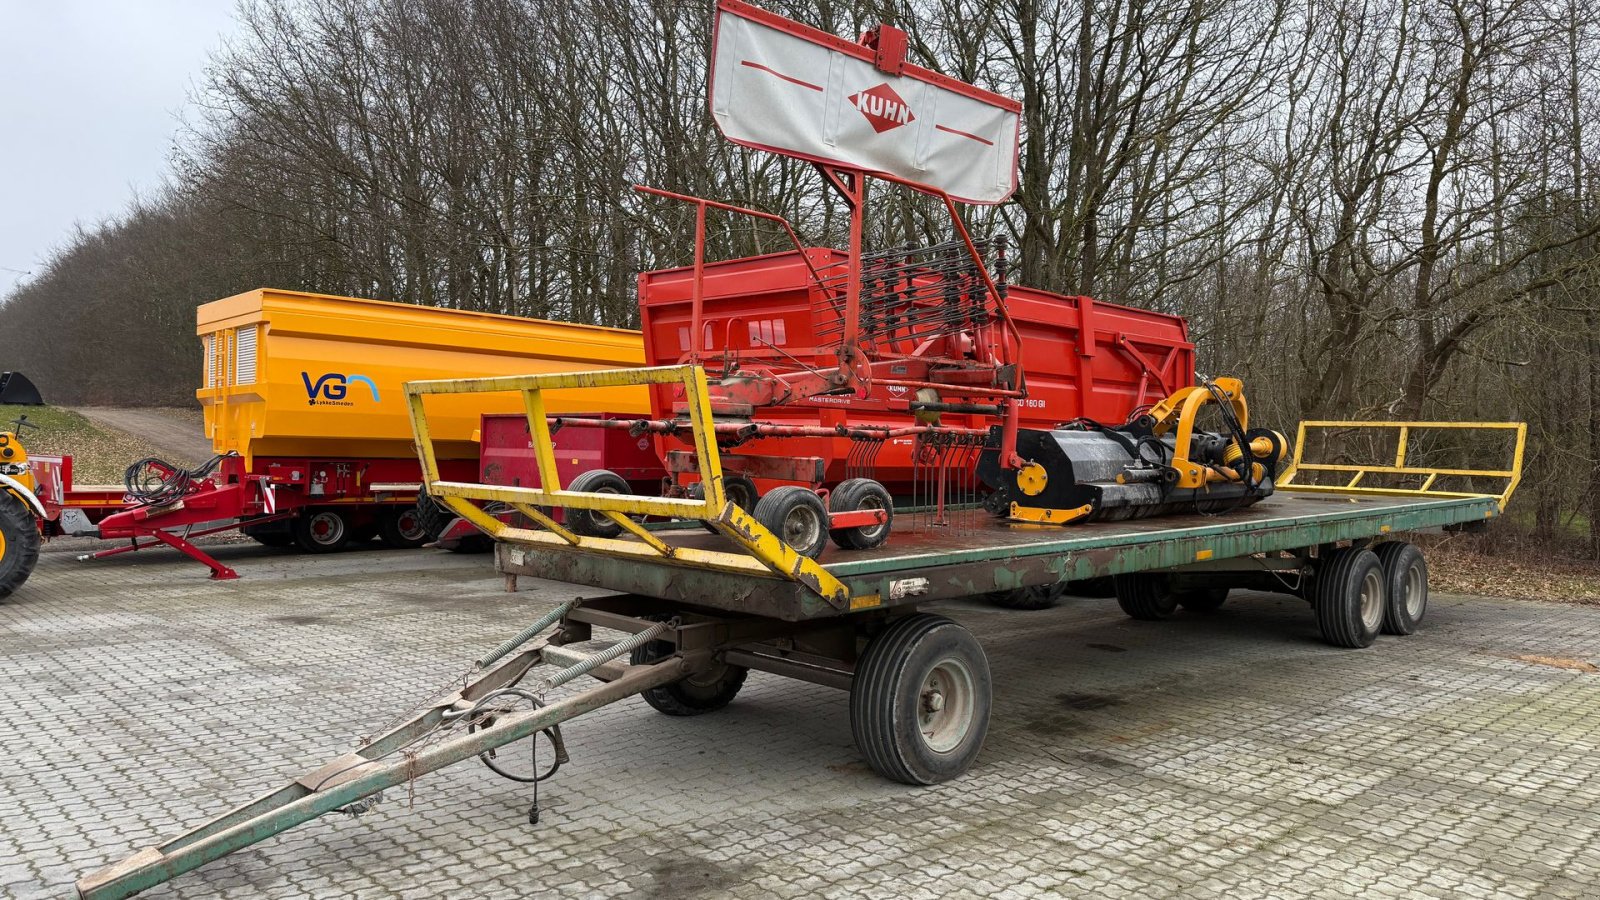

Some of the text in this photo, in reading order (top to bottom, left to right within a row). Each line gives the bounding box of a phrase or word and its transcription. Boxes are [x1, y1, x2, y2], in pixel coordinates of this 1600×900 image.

[857, 91, 910, 126] KUHN
[808, 396, 851, 405] MASTERDRIVE
[1026, 399, 1038, 408] 160
